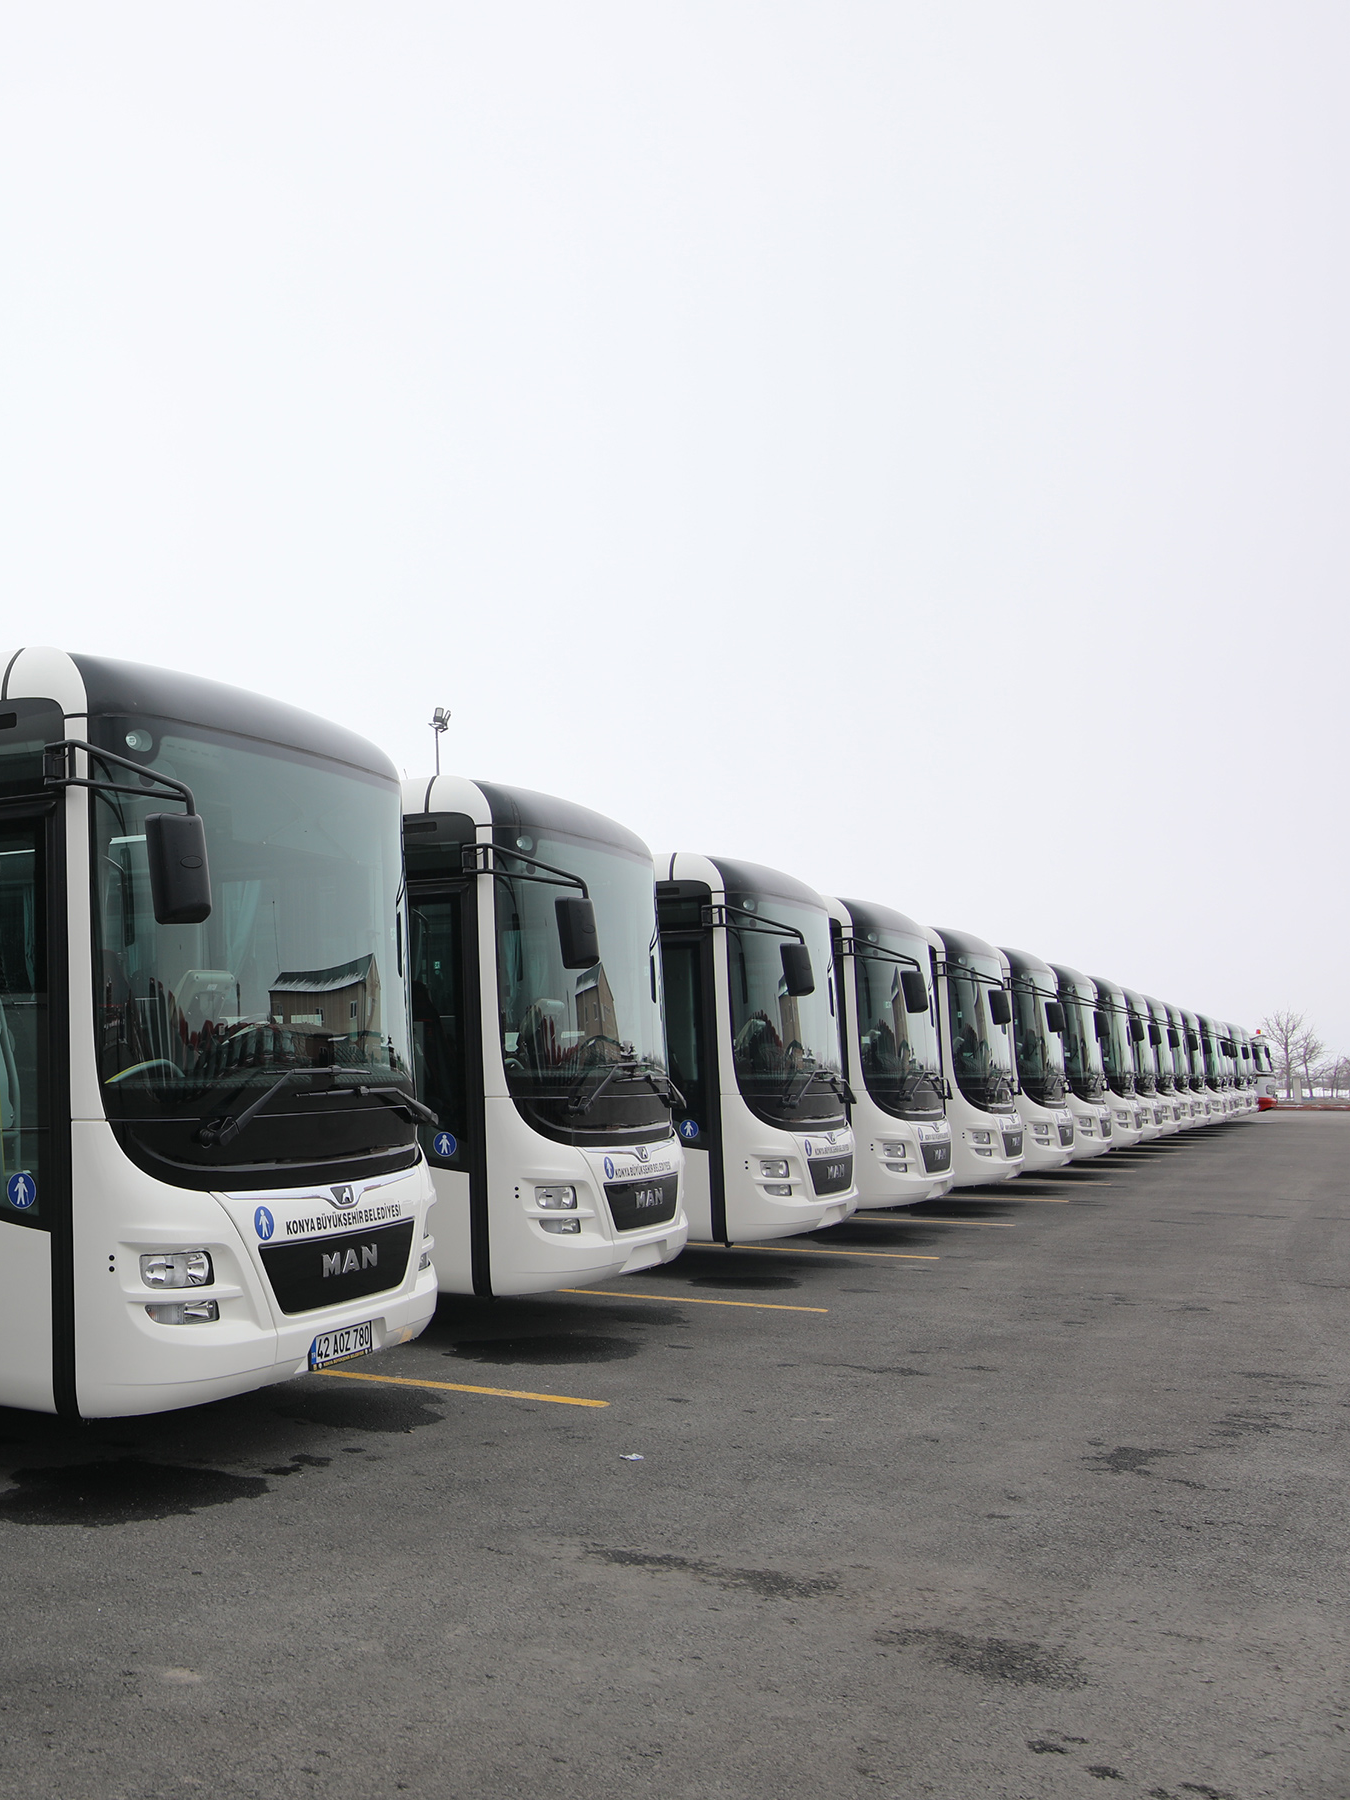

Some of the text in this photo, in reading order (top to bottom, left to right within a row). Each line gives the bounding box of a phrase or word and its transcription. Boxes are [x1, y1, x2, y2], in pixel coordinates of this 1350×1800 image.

[635, 1187, 663, 1209] MAN
[286, 1201, 402, 1235] KONYA BÜYÜKŞEHİR BELEDİYESİ
[321, 1243, 378, 1278] MAN
[317, 1337, 330, 1359] 42
[333, 1330, 351, 1355] AOZ
[353, 1325, 370, 1349] 780
